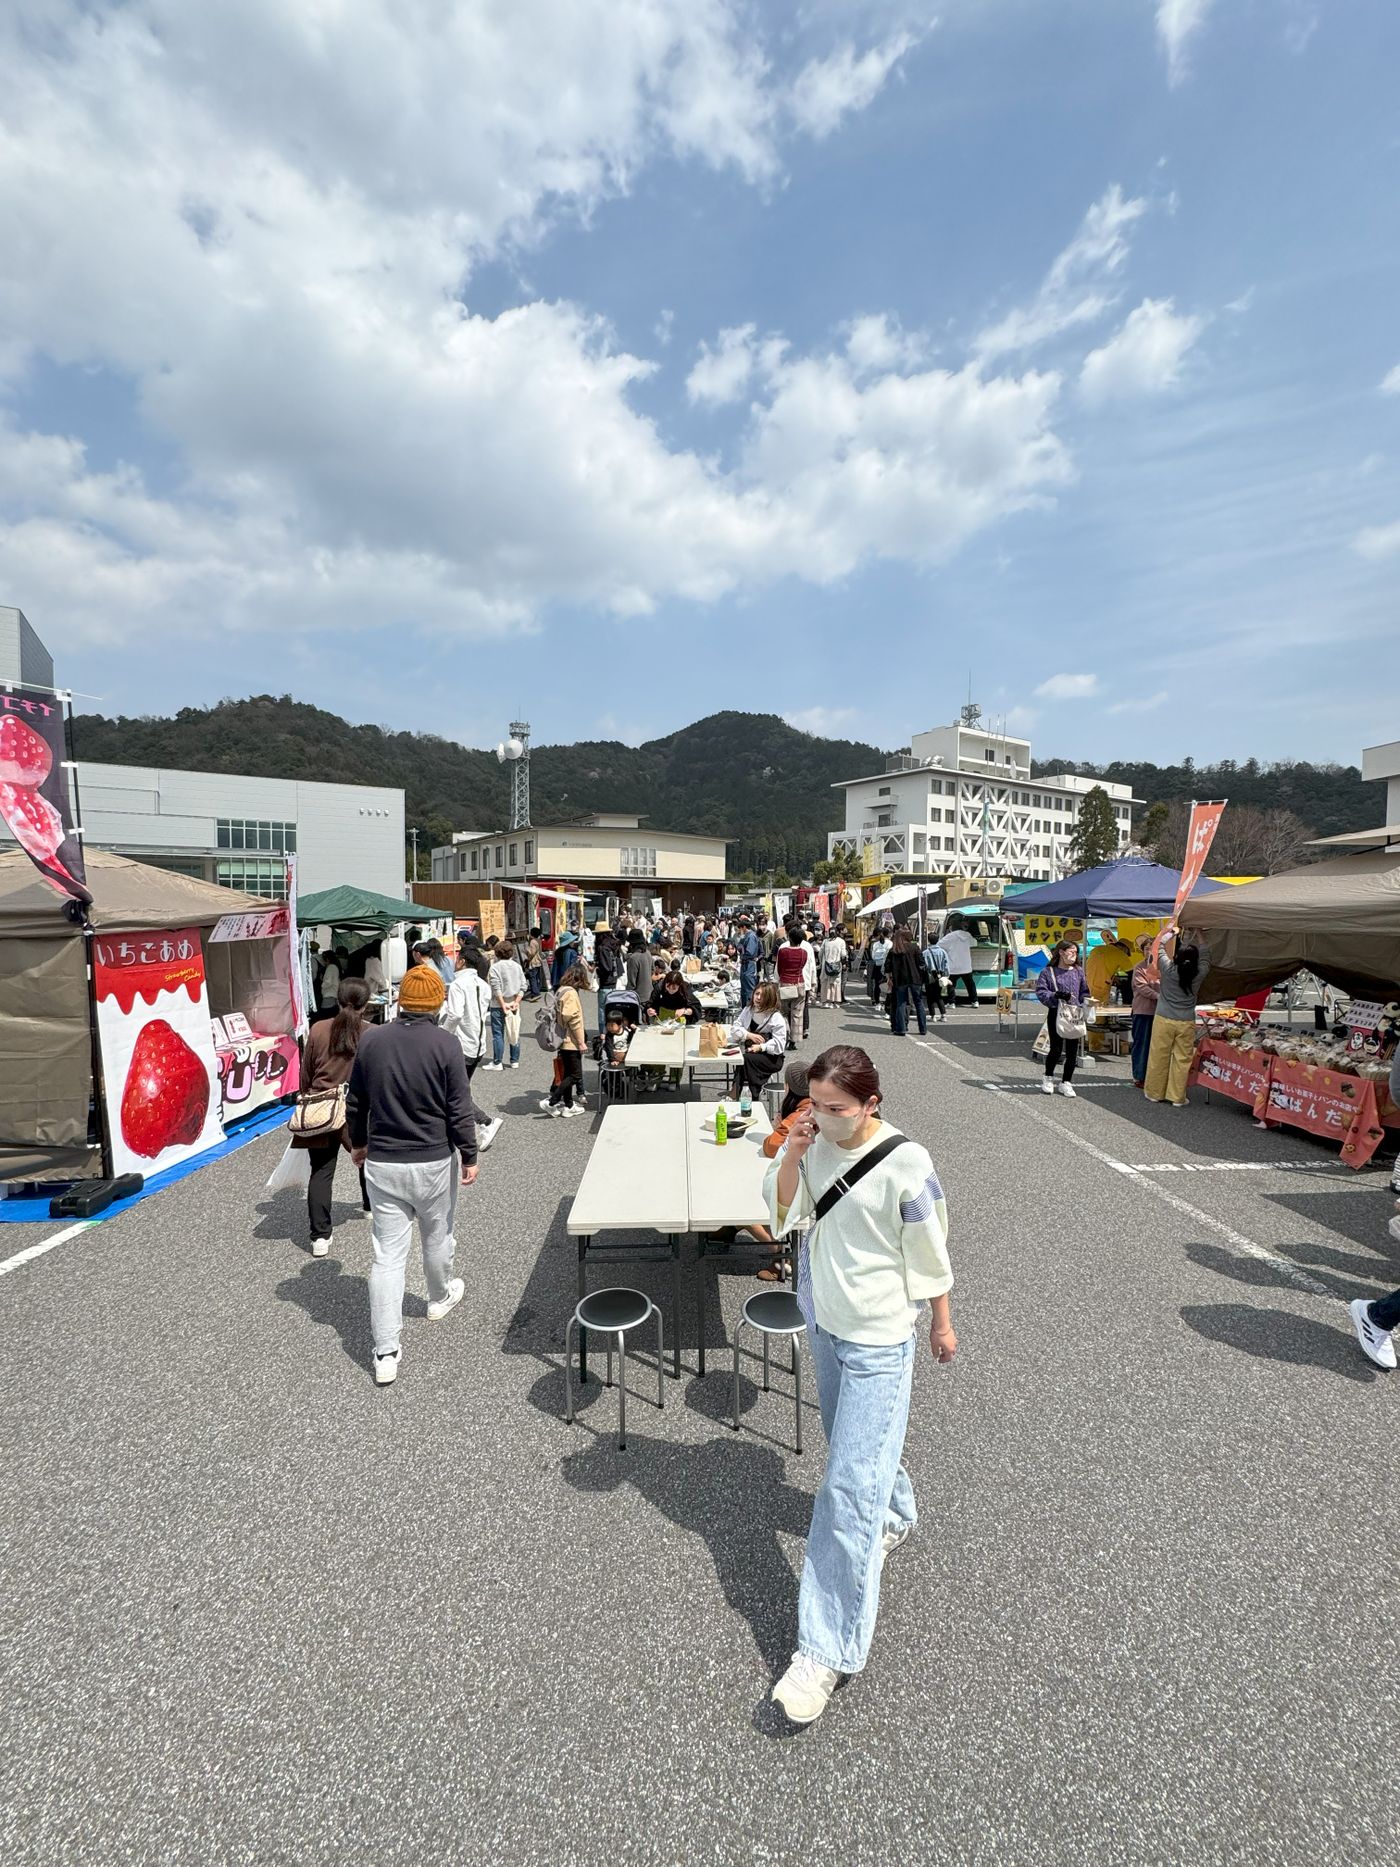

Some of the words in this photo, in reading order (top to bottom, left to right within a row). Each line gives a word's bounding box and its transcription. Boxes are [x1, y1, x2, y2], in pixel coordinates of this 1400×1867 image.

[96, 939, 194, 967] いちごあめ
[164, 967, 195, 982] Strawberry
[184, 971, 201, 982] Candy
